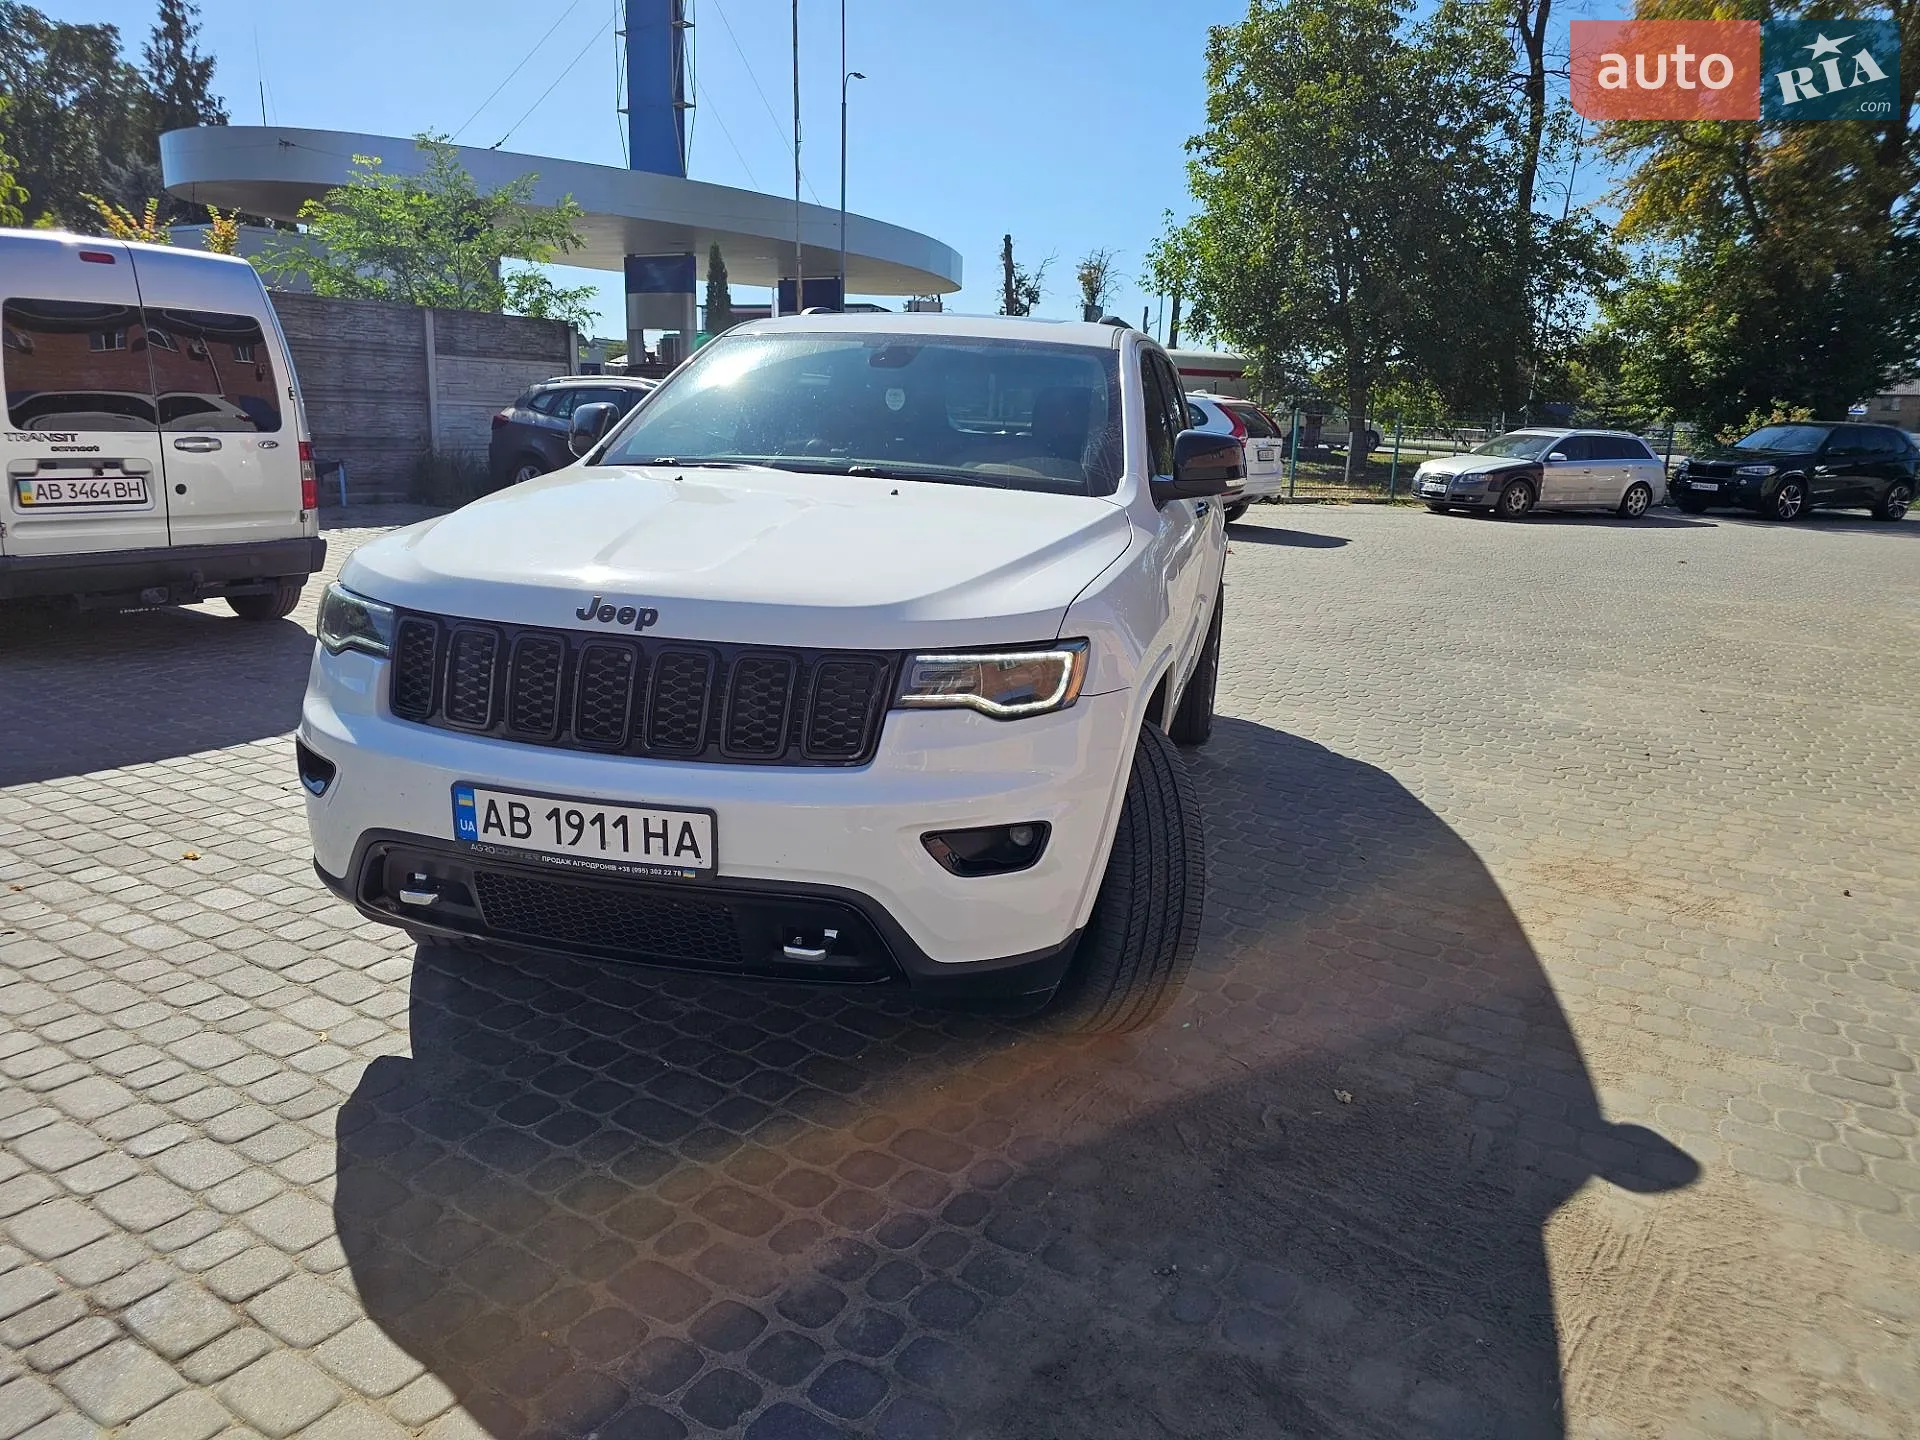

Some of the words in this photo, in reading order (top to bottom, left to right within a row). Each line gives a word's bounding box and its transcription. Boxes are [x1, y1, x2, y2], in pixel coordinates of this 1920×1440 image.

[3, 432, 79, 442] TRANSIT
[36, 483, 62, 500] AB
[67, 482, 111, 499] 3464
[114, 481, 141, 498] BH
[576, 594, 659, 631] Jeep
[460, 818, 476, 832] UA
[482, 798, 532, 839] AB
[545, 807, 629, 853] 1911
[642, 817, 702, 859] HA
[541, 855, 572, 866] ПРОДАЖ
